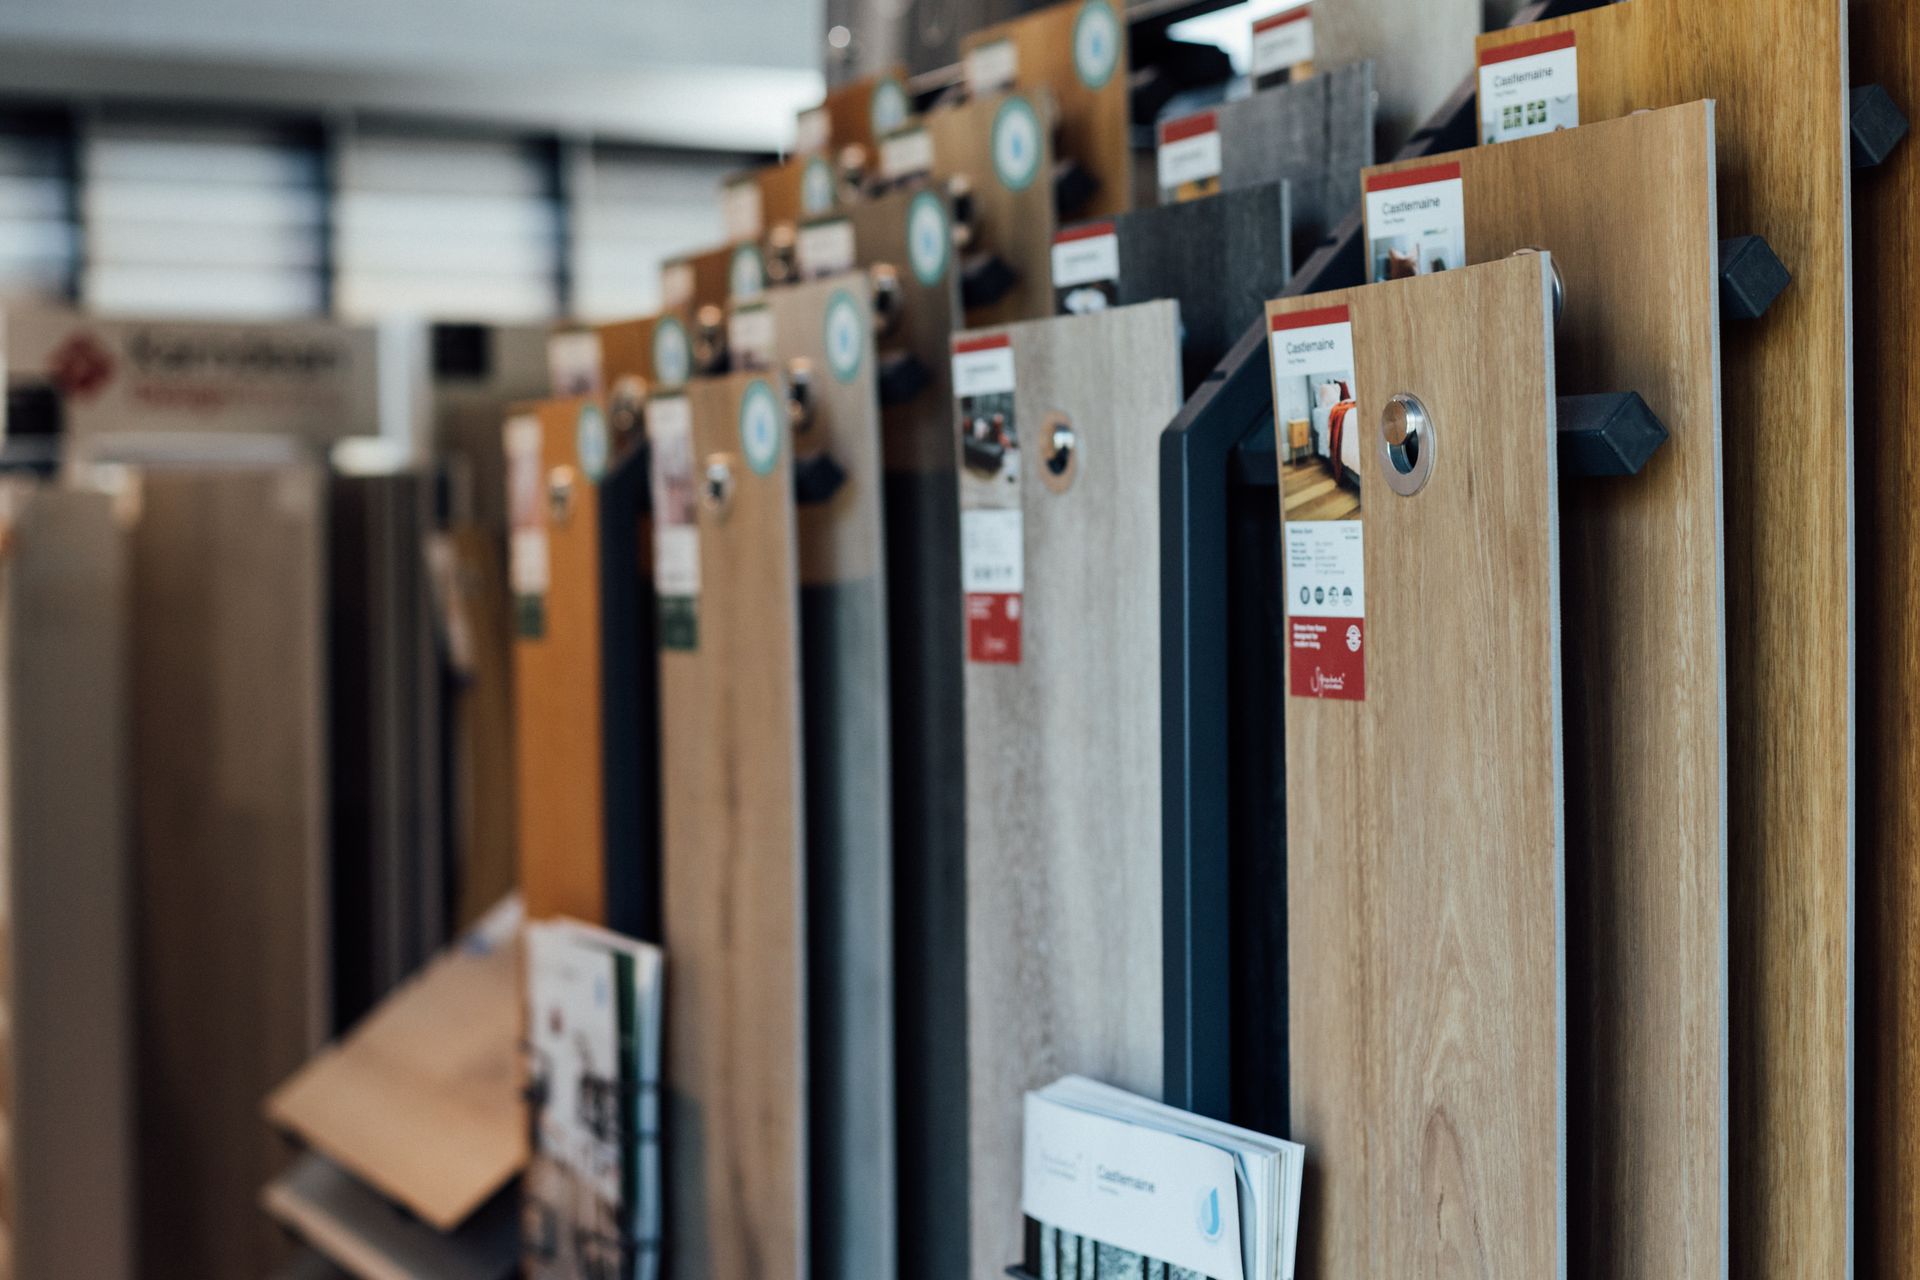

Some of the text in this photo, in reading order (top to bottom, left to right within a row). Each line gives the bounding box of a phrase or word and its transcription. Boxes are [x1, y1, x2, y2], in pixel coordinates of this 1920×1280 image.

[1494, 66, 1553, 88] Castlemaine
[1382, 196, 1441, 215] Castlemaine
[1286, 338, 1335, 355] Castlemaine
